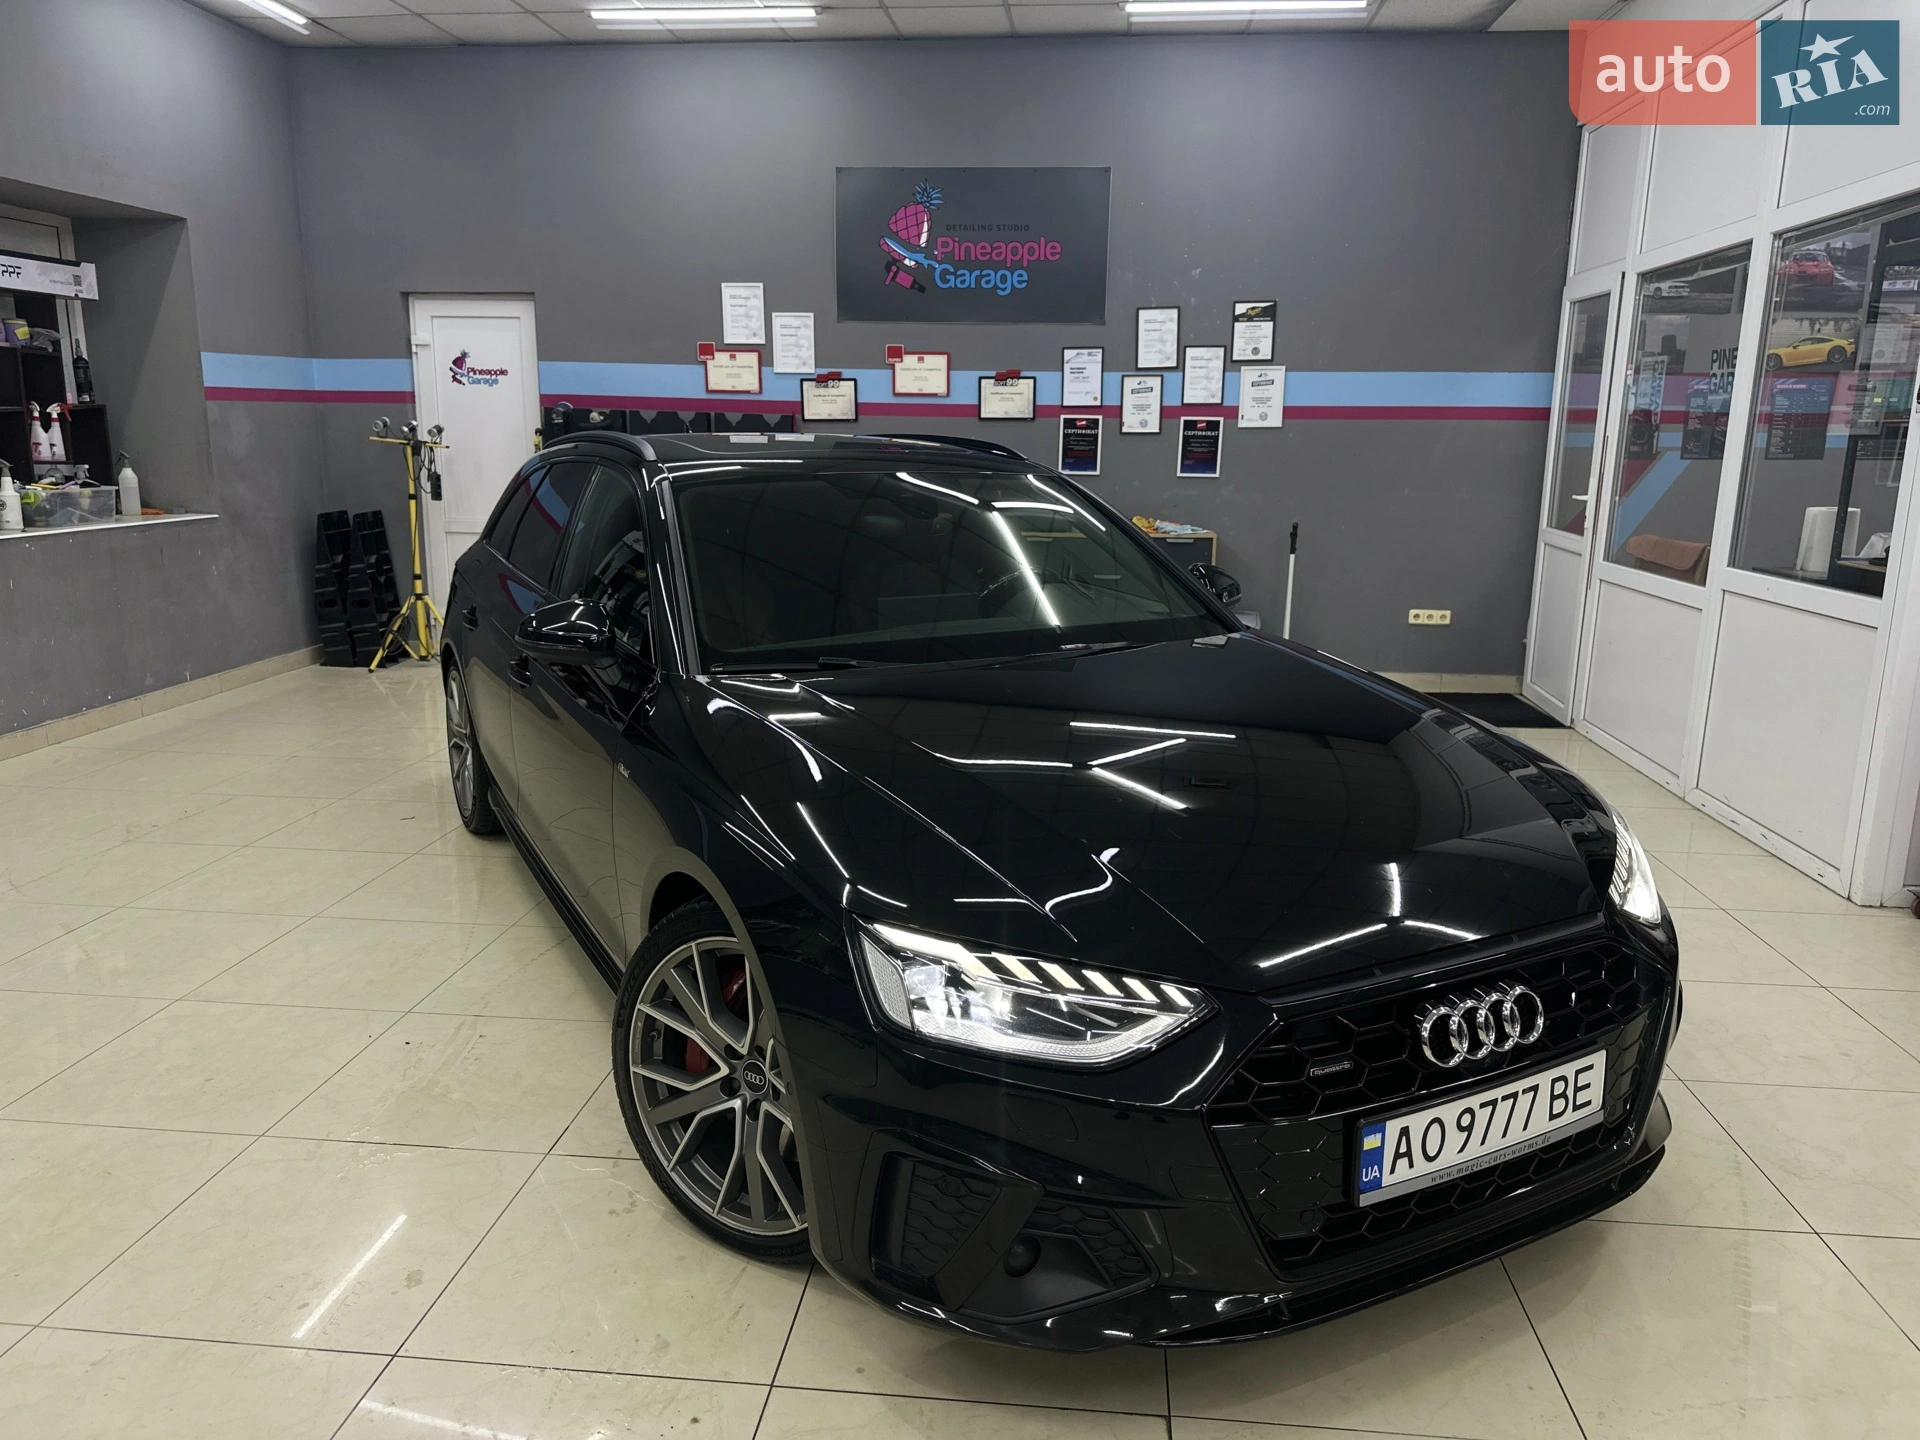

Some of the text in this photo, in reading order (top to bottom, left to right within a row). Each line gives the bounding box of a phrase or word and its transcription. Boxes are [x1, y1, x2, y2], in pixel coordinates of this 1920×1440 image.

[946, 224, 1030, 232] DETAILING STUDIO
[936, 236, 1061, 267] Pineapple
[934, 263, 1028, 296] Garage
[467, 367, 508, 377] Pineapple
[467, 376, 499, 387] Garage
[1314, 1062, 1350, 1076] quattro
[1389, 1063, 1594, 1175] AO 9777 BE
[1431, 1135, 1551, 1184] www.magic-cars-worms.de
[1362, 1165, 1380, 1182] UA
